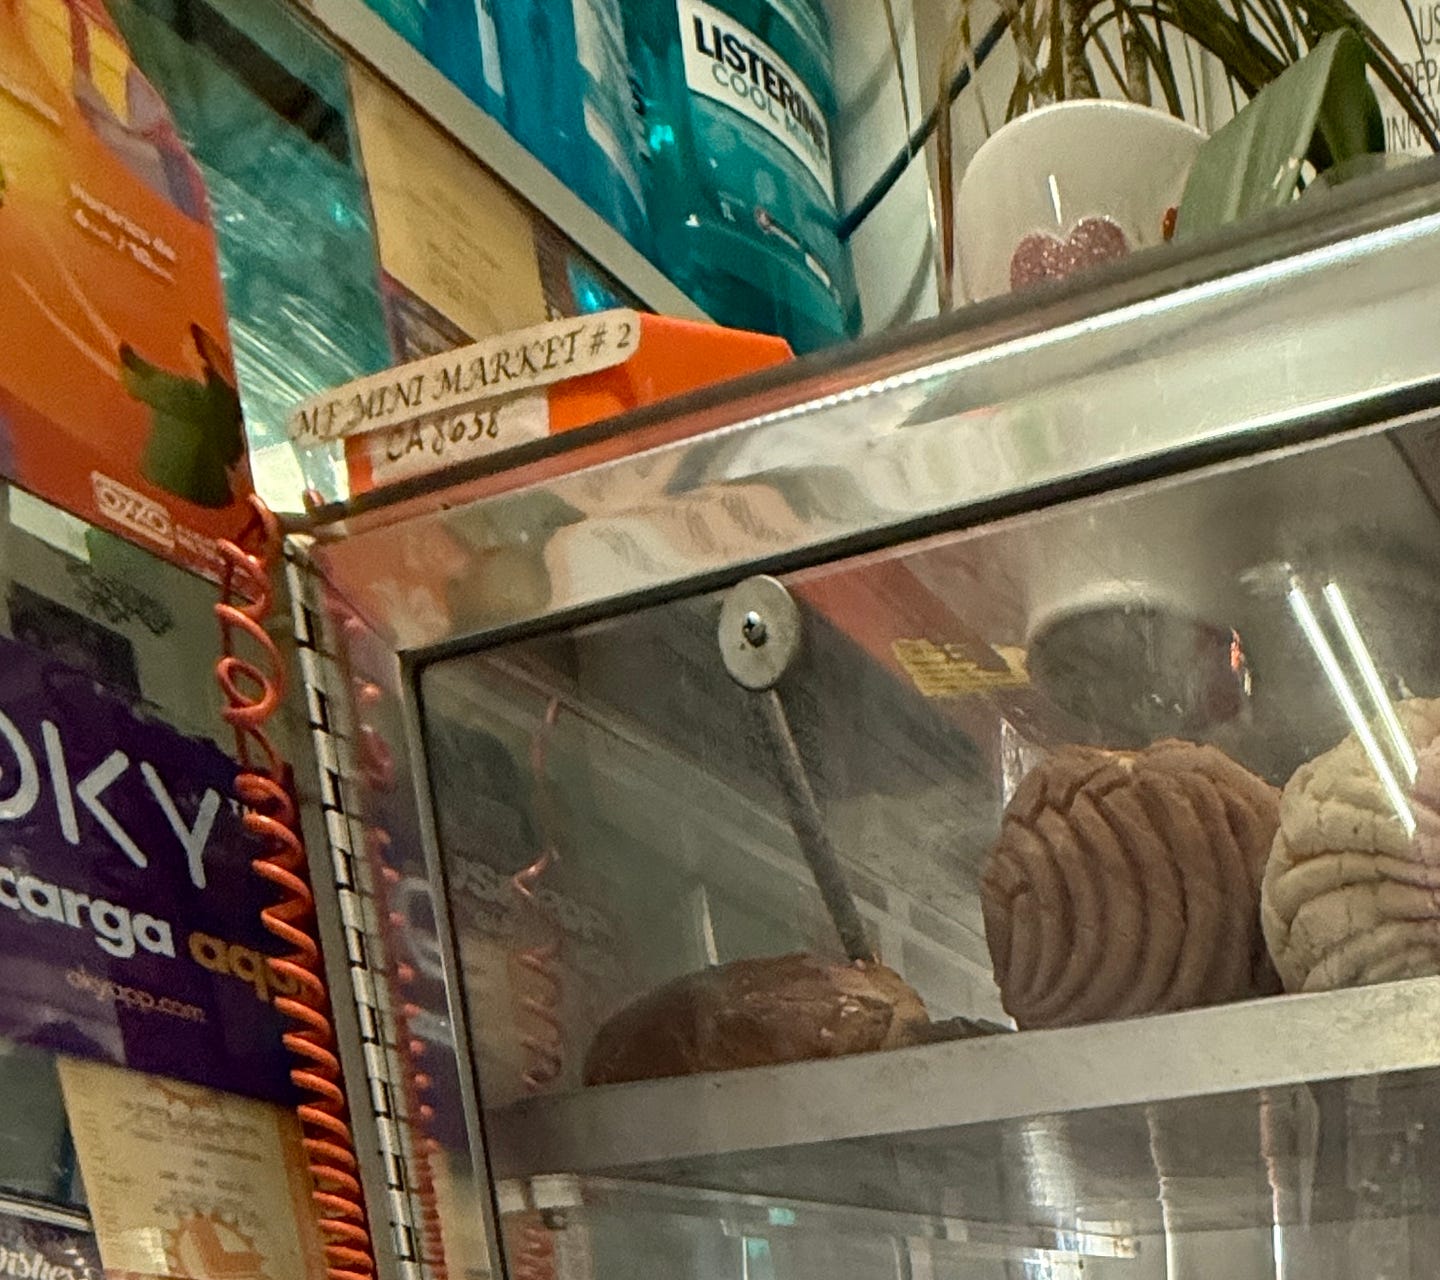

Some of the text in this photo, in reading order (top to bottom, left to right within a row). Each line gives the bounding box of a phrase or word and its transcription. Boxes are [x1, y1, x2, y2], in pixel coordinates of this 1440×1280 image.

[711, 63, 779, 123] COOL
[348, 374, 426, 429] MINI
[432, 327, 586, 393] MARKET
[617, 322, 633, 349] 2
